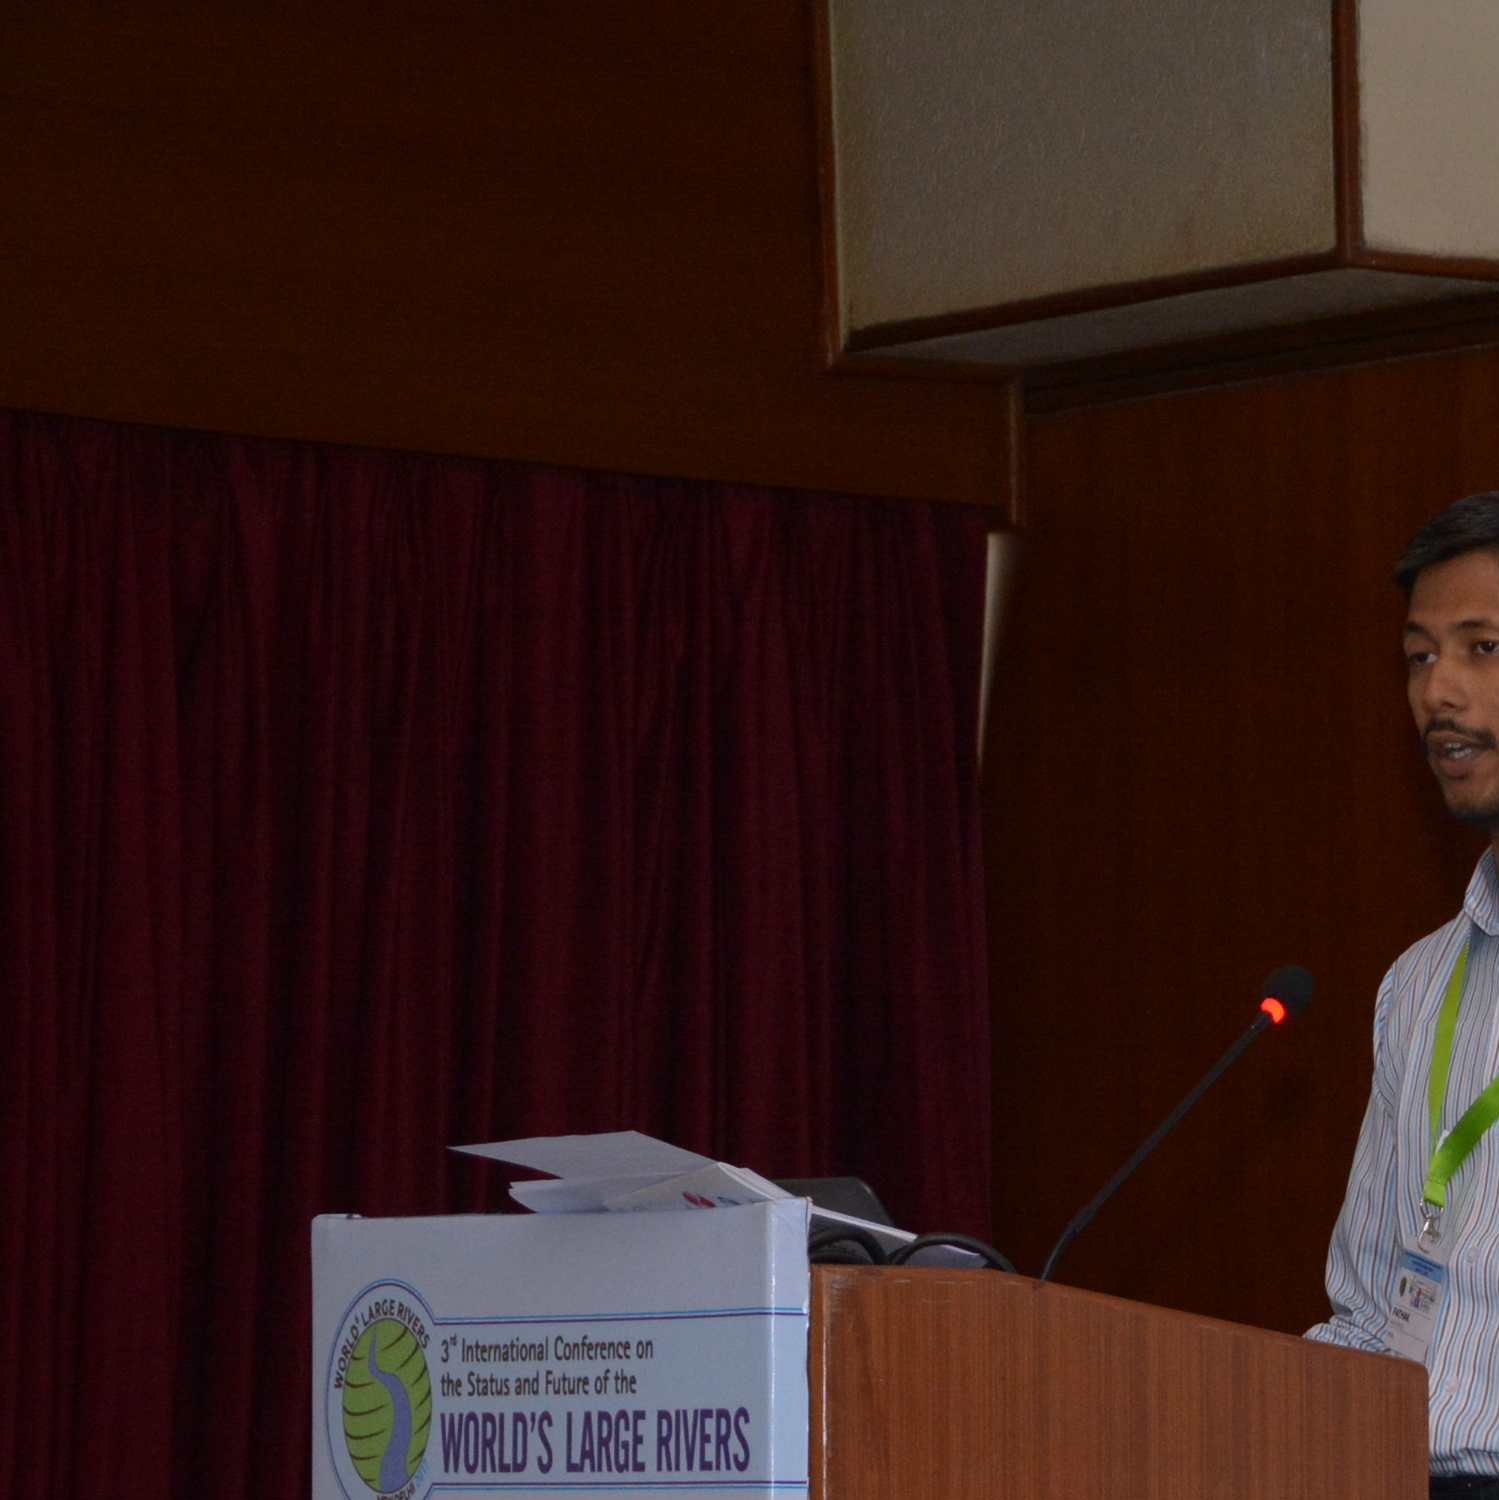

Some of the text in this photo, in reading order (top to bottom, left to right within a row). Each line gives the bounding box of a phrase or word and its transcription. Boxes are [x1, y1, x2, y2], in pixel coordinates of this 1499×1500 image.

[361, 1299, 395, 1327] LARGE
[397, 1301, 431, 1349] RIVERS
[441, 1333, 654, 1363] 3rd International Conference on
[440, 1368, 637, 1397] the Status and Future of the
[440, 1406, 750, 1474] WORLD'S LARGE RIVERS
[414, 1457, 430, 1488] 2017
